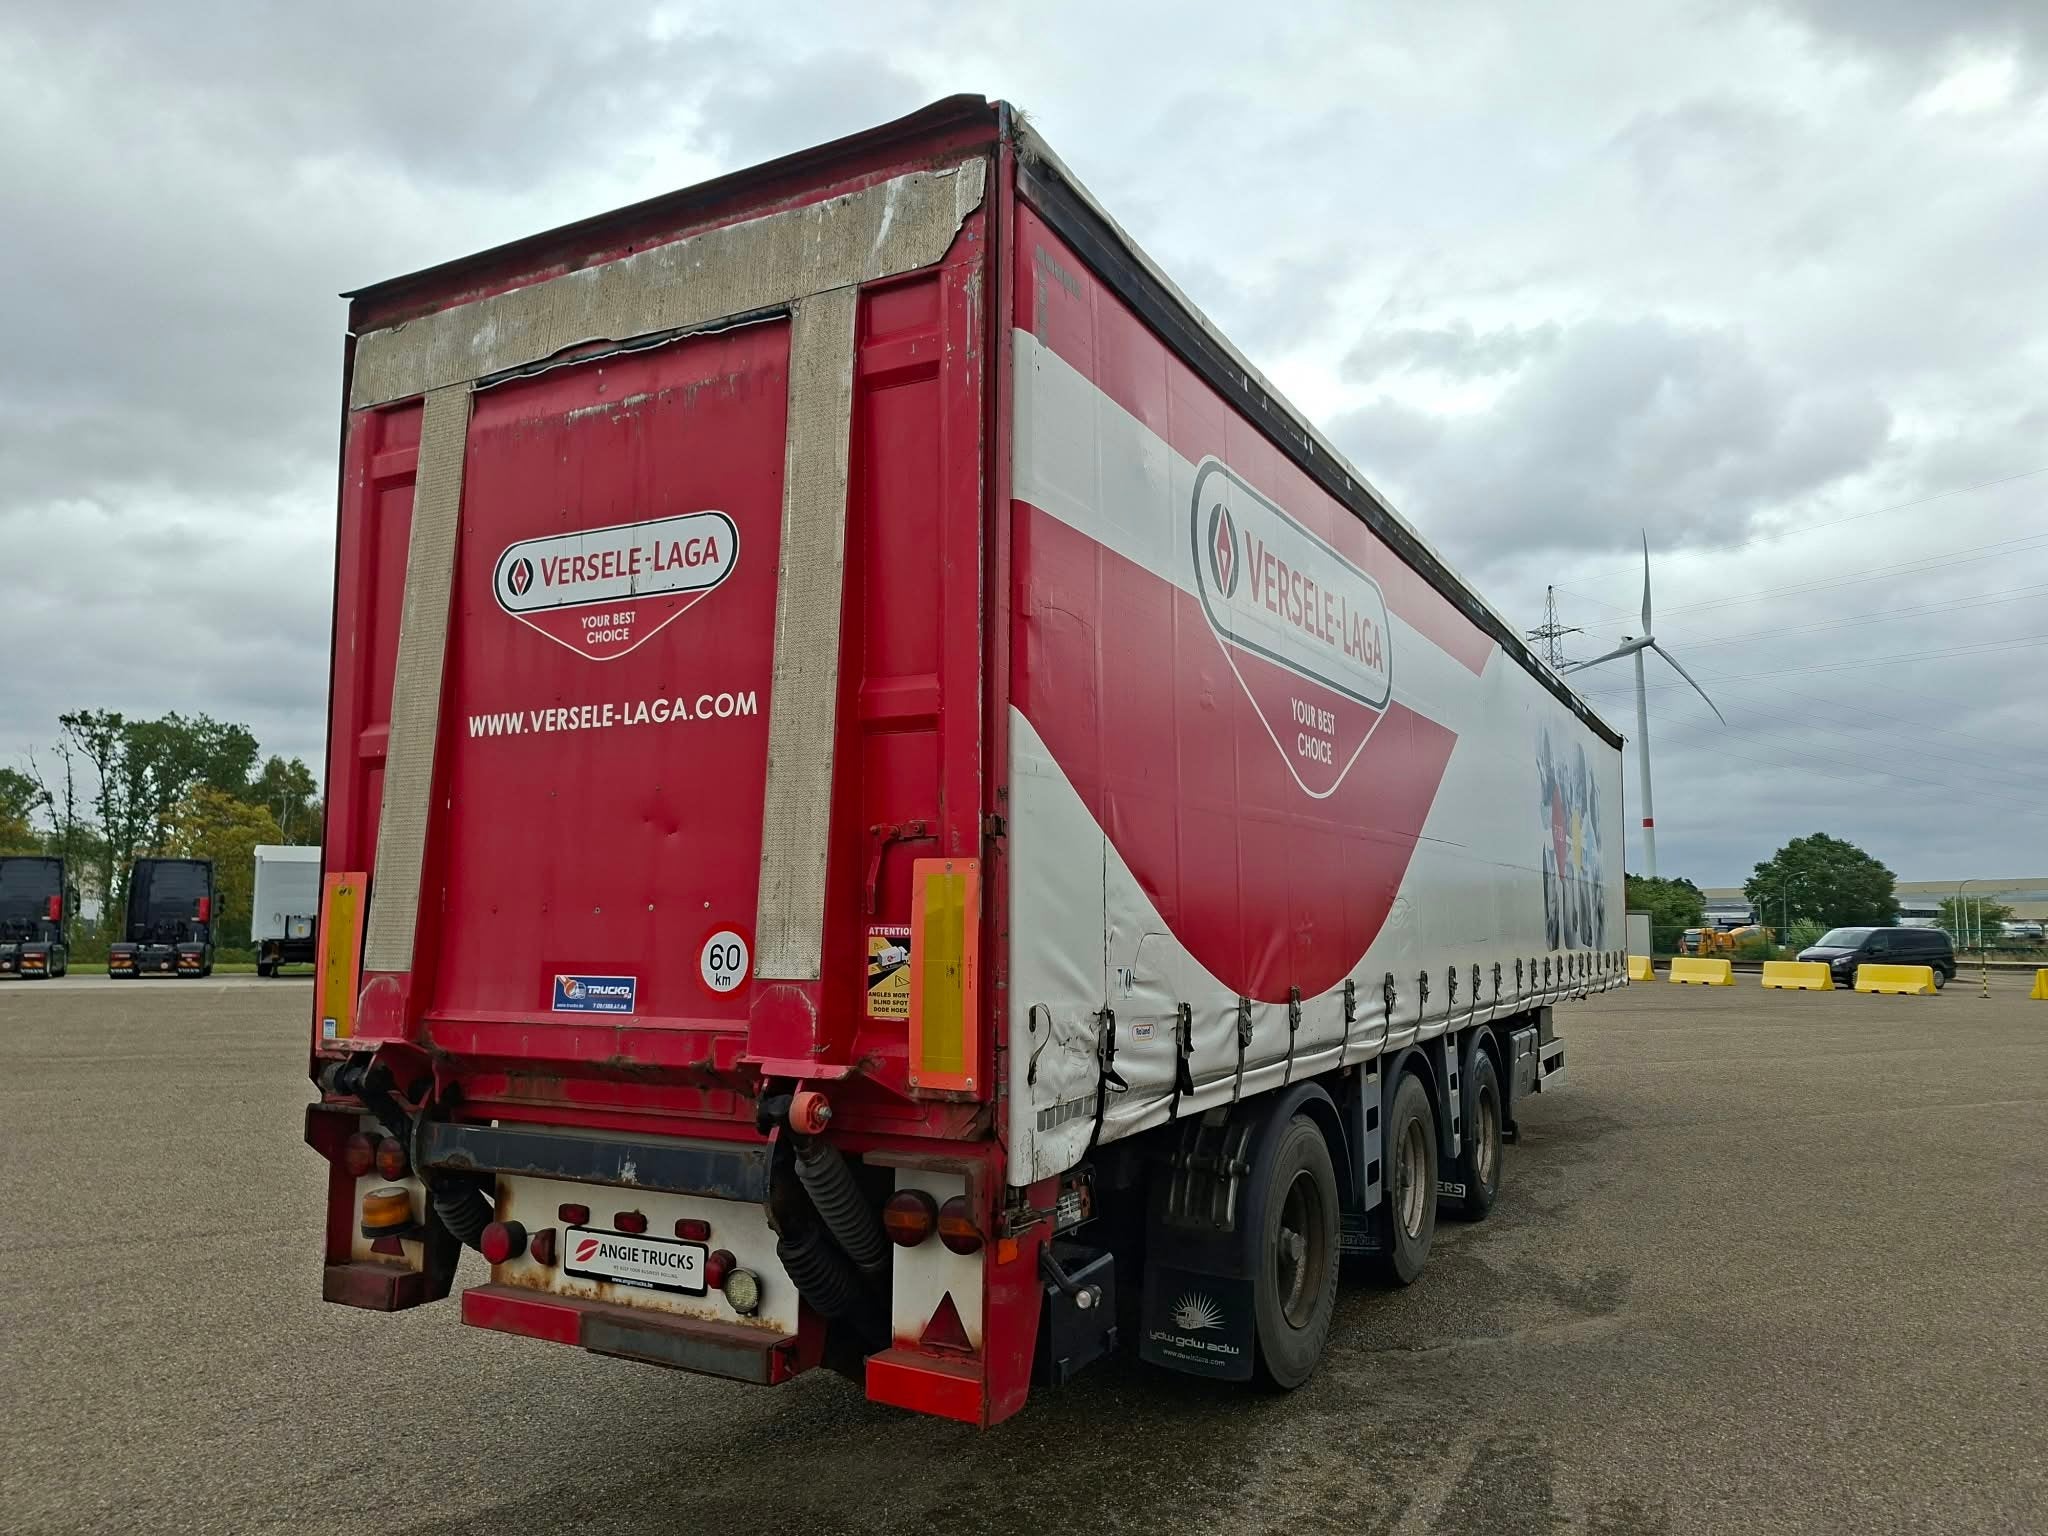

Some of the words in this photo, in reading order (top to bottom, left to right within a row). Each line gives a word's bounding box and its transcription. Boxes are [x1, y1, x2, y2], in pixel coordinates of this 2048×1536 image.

[540, 536, 720, 587] VERSELE-LAGA
[1244, 529, 1385, 674] VERSELE-LAGA
[581, 614, 611, 629] YOUR
[613, 611, 636, 626] BEST
[586, 628, 630, 644] CHOICE
[468, 691, 759, 738] WWW.VERSELE-LAGA.COM
[1290, 697, 1317, 730] YOUR
[1317, 708, 1336, 736] BEST
[1297, 732, 1333, 765] CHOICE
[708, 943, 741, 972] 60
[714, 972, 732, 987] km
[1437, 1181, 1462, 1193] ERS
[598, 1243, 639, 1263] ANGIE
[641, 1248, 694, 1271] TRUCKS
